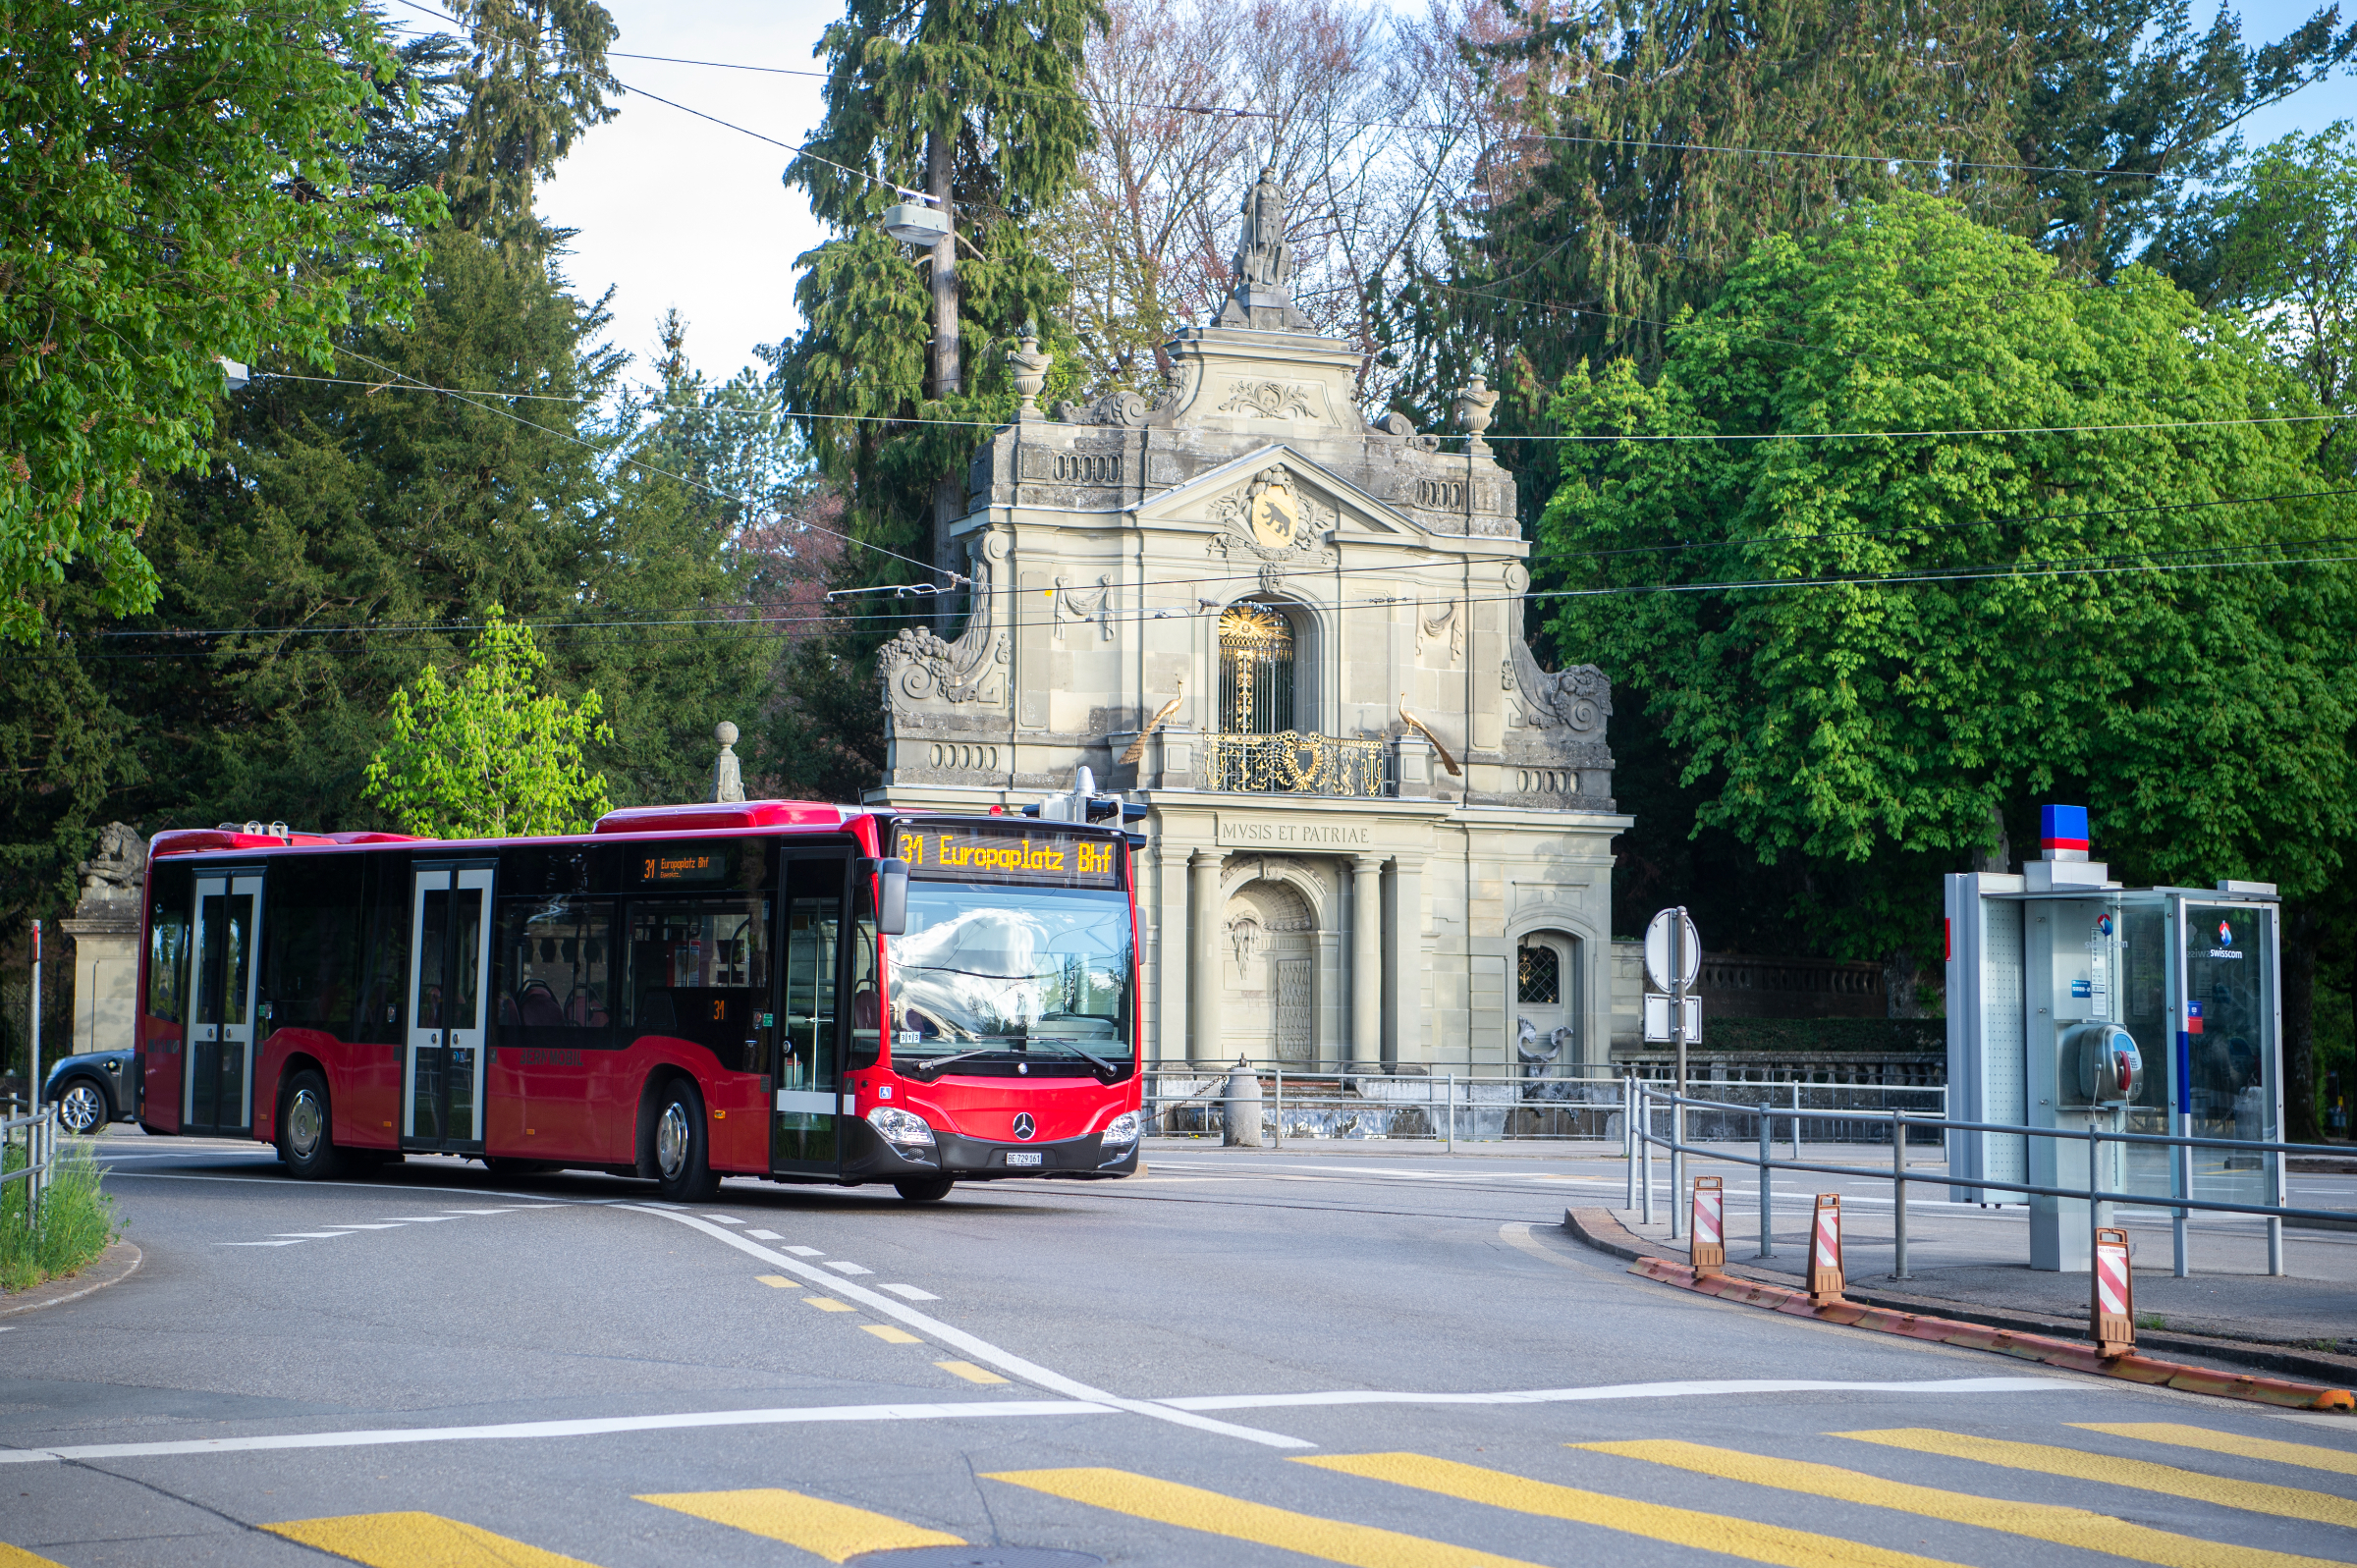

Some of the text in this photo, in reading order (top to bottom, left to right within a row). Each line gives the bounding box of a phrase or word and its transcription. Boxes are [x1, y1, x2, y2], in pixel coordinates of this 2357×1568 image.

[1223, 823, 1369, 843] MVSIS ET PATRIAE
[900, 834, 1112, 873] 31 Europaplatz Bhf
[643, 856, 709, 879] 31 Europaplatz Bhf
[2084, 940, 2128, 949] swscom
[2210, 946, 2243, 959] swisscom
[713, 1000, 725, 1020] 31
